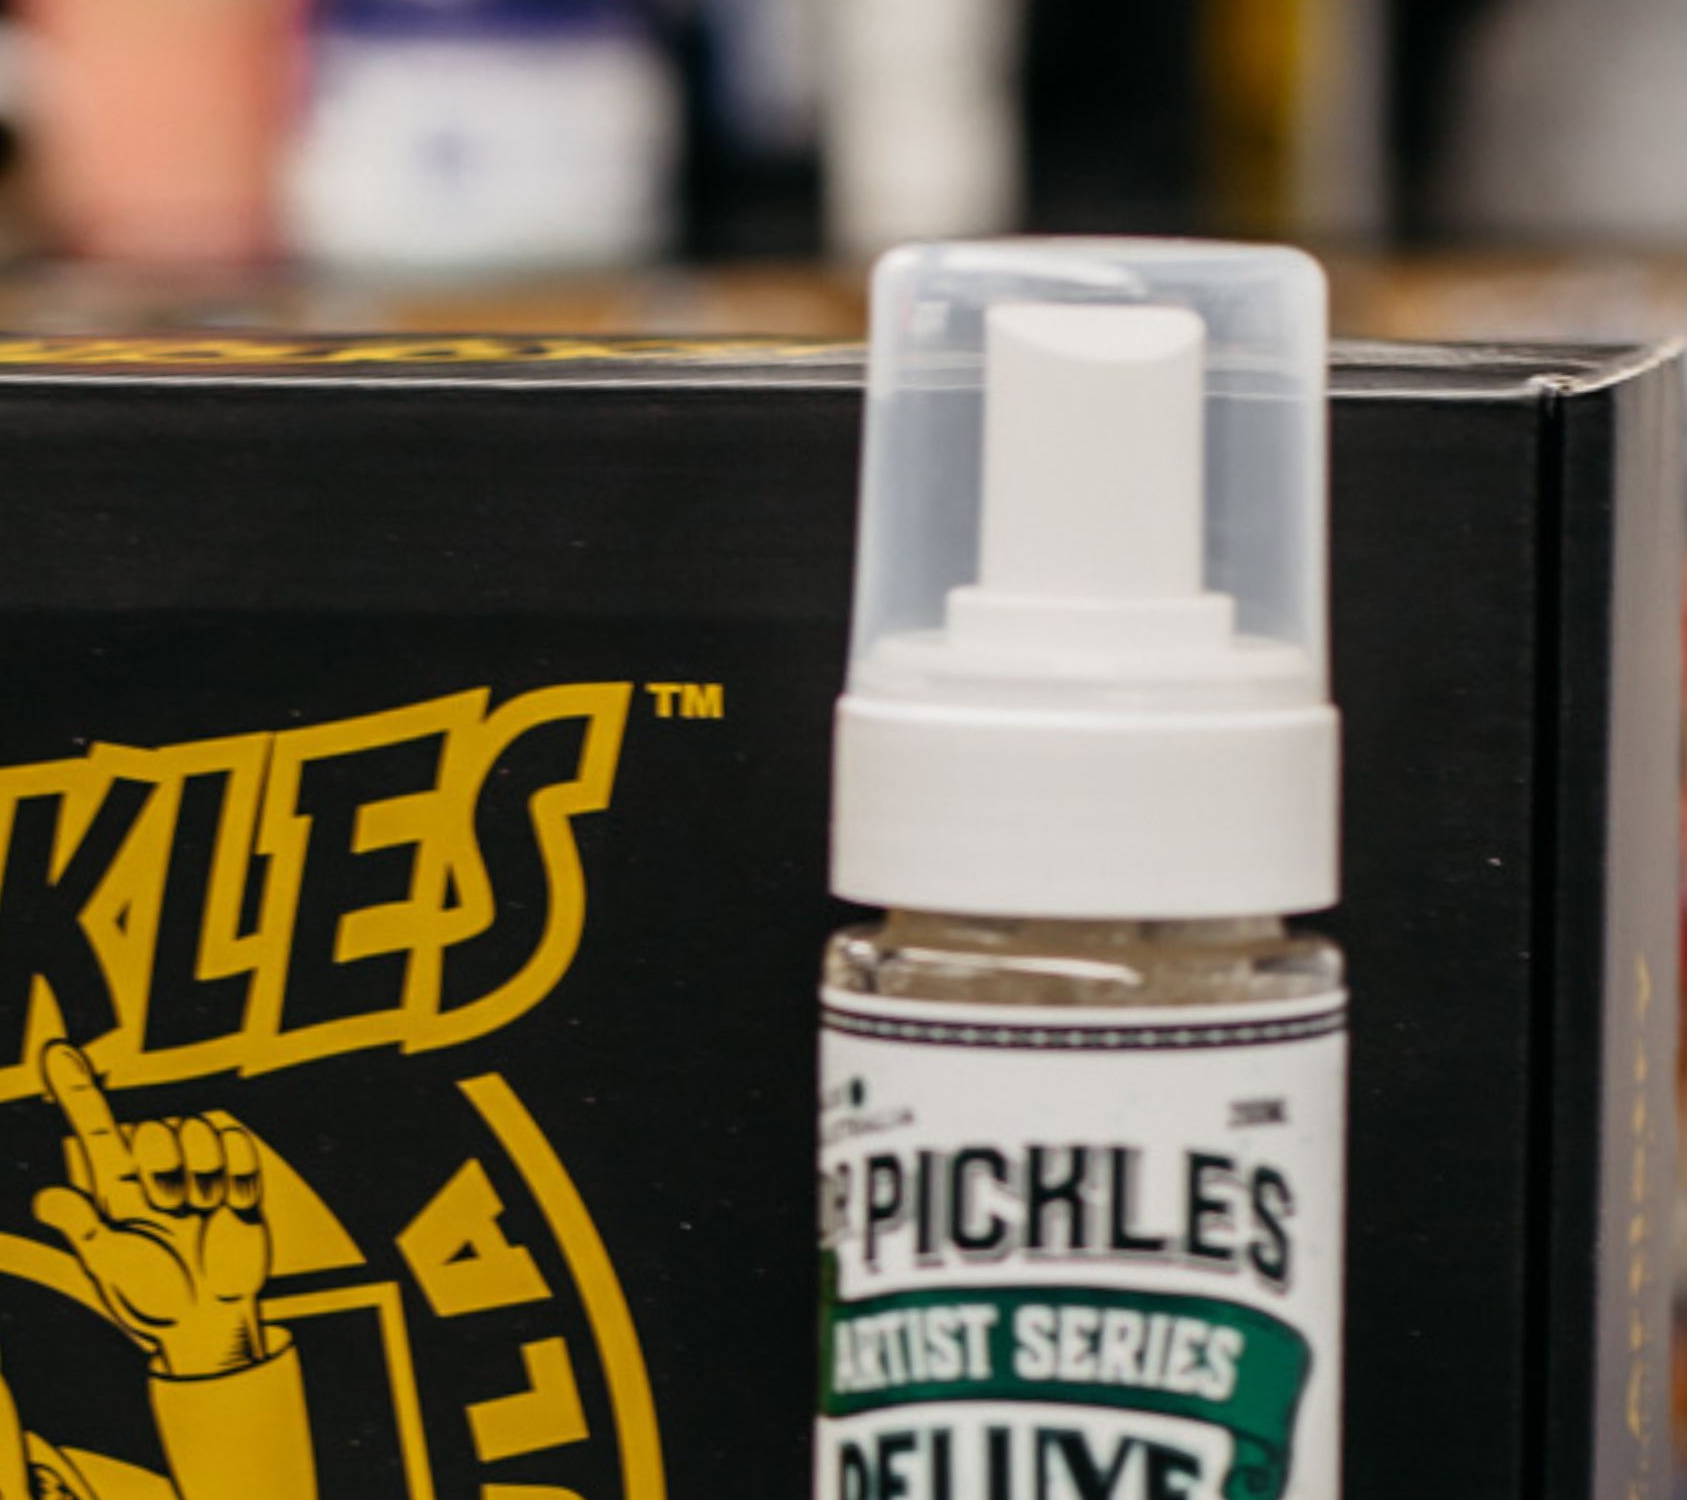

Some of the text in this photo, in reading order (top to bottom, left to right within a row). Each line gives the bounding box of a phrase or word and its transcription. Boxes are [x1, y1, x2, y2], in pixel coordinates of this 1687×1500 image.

[646, 683, 724, 721] TM
[864, 1142, 1296, 1296] PICKLES
[833, 1303, 1245, 1402] ARTIST SERIES
